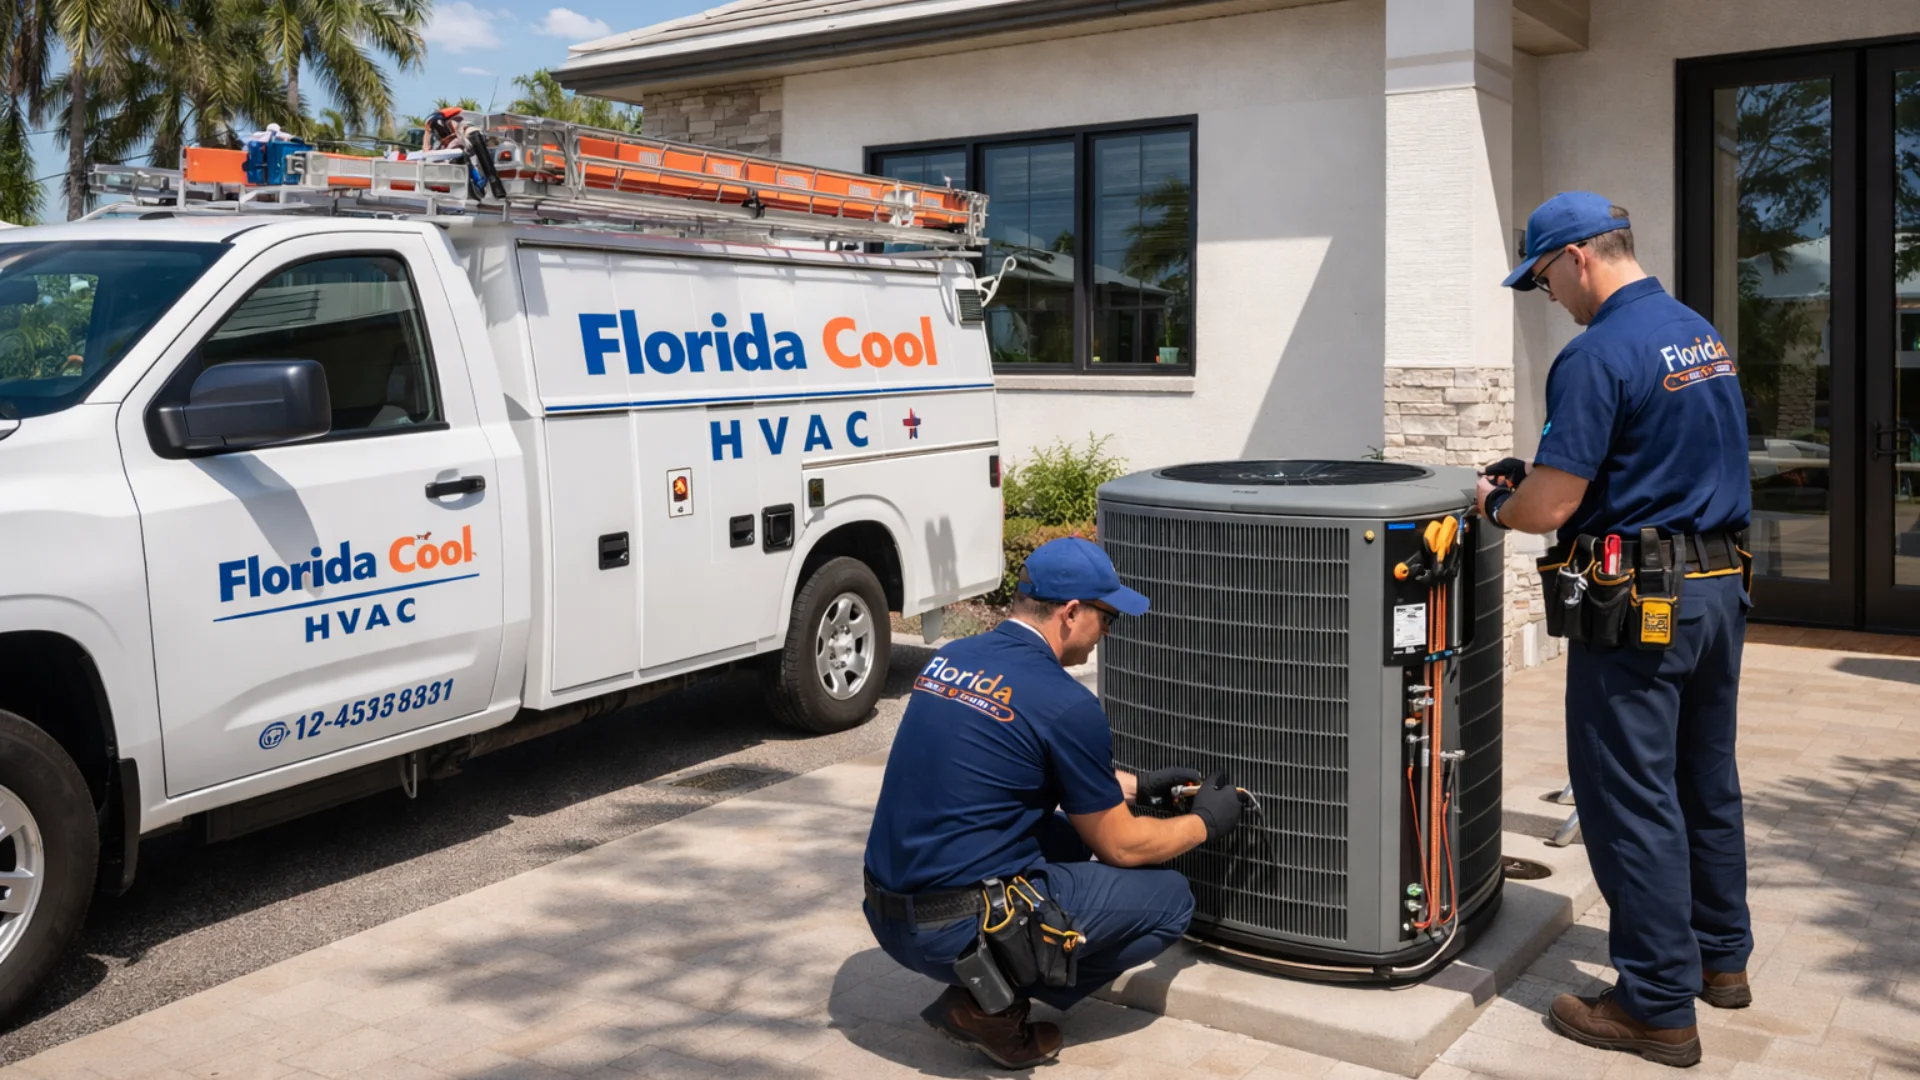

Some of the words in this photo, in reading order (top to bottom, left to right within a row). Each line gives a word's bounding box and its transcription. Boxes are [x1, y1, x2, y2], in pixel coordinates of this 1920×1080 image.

[577, 308, 808, 376] Florida
[821, 315, 939, 369] Cool
[709, 410, 870, 462] HVAC
[218, 540, 377, 603] Florida
[388, 524, 473, 574] Cool
[304, 597, 417, 643] HVAC
